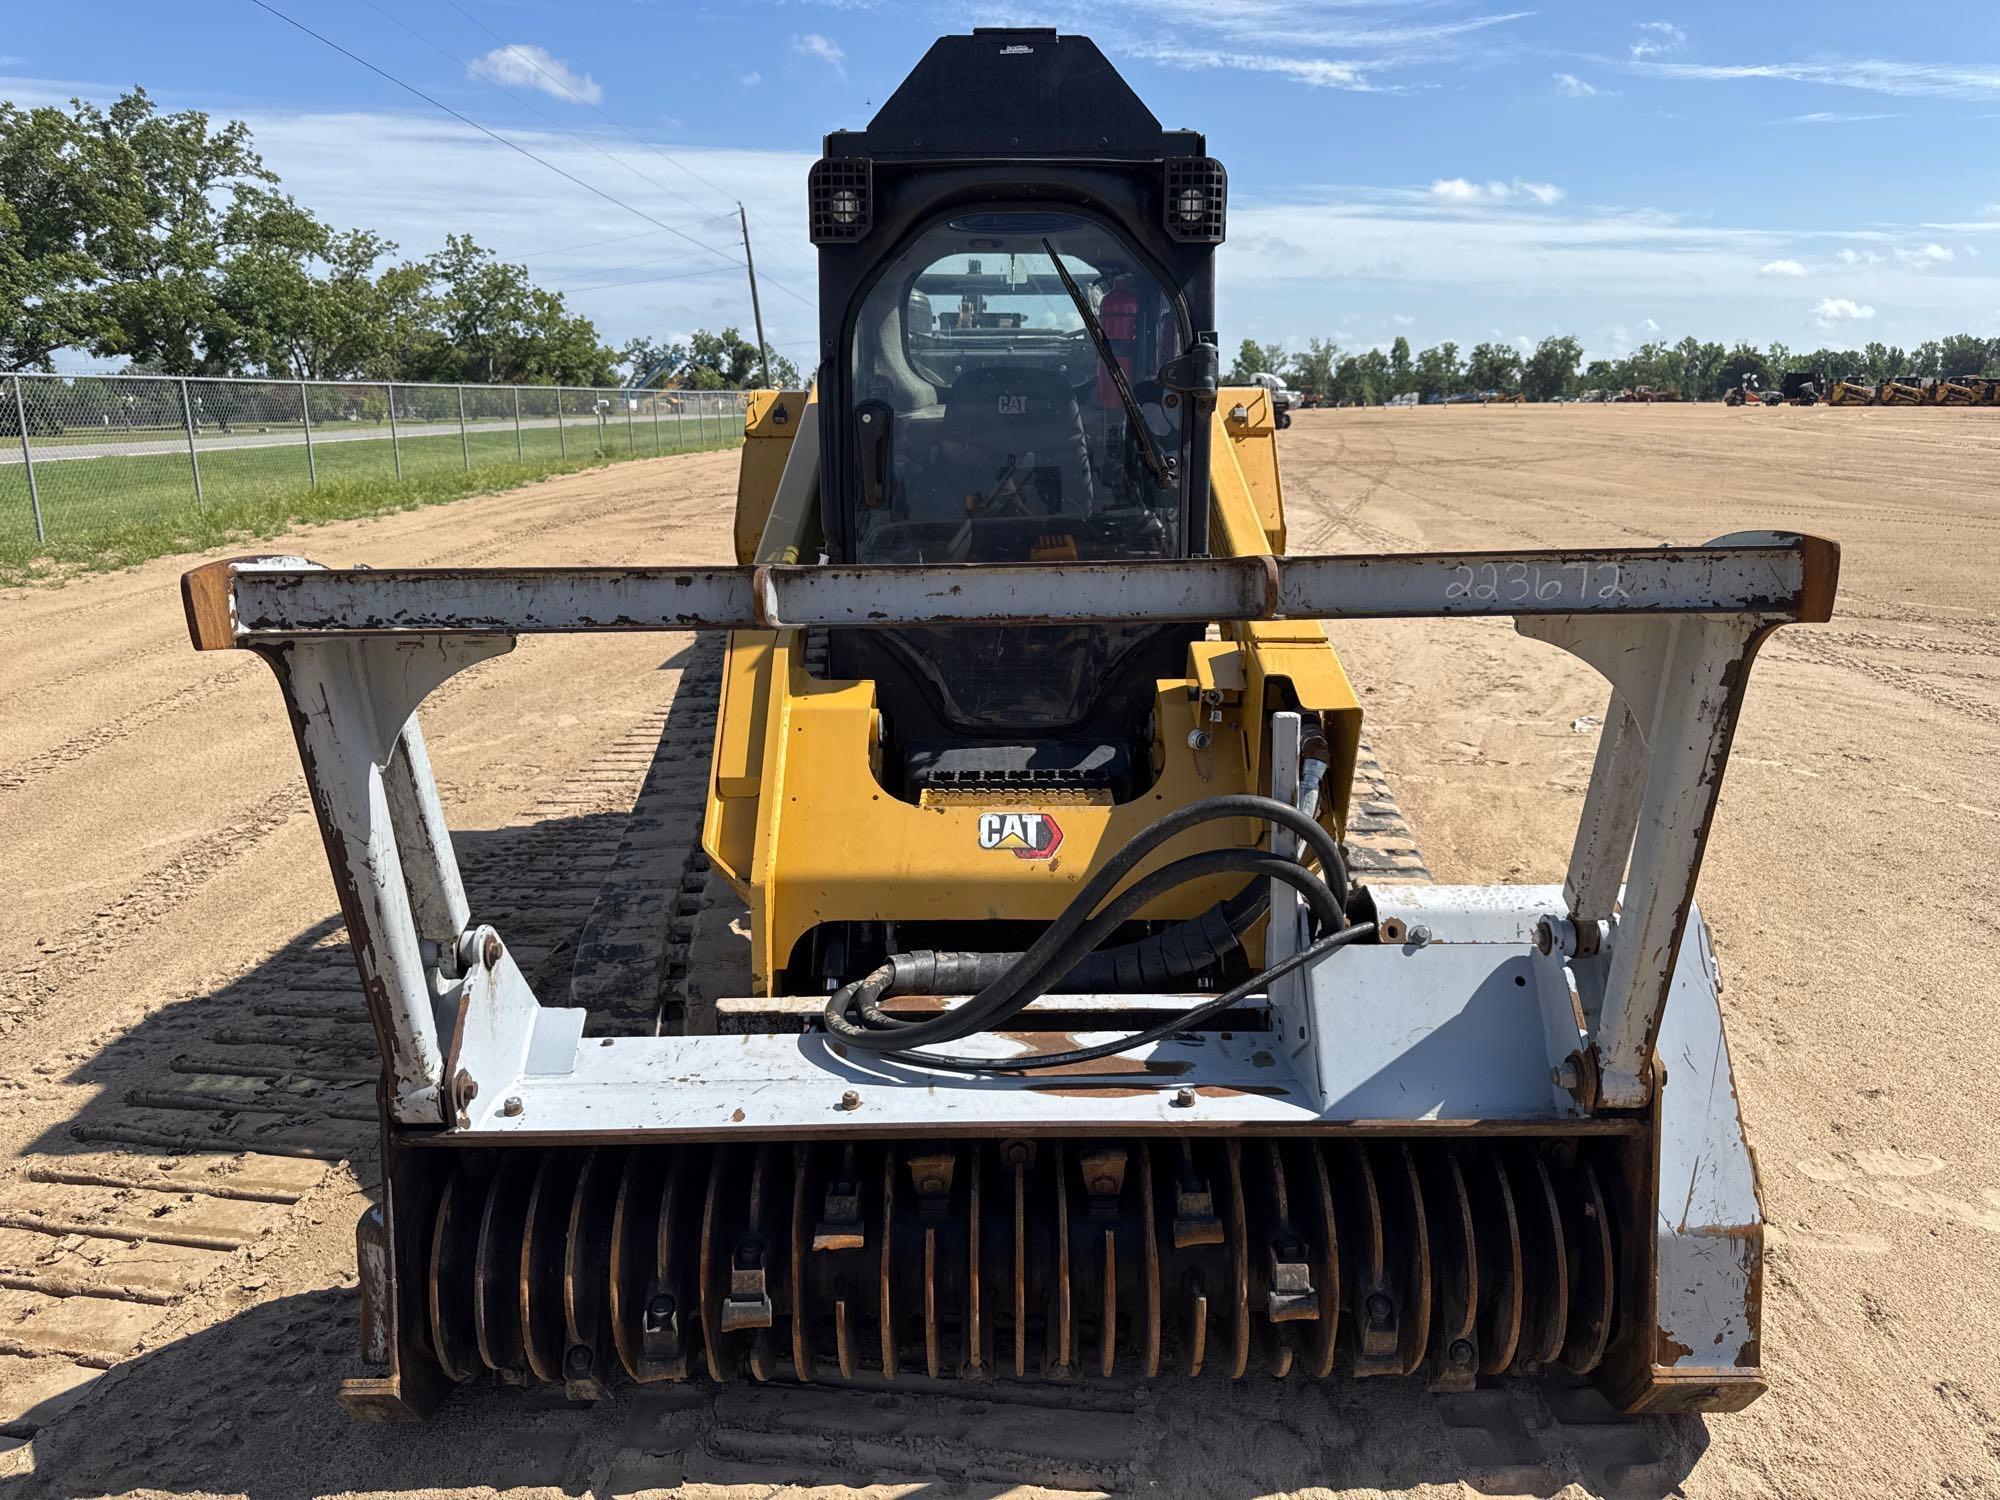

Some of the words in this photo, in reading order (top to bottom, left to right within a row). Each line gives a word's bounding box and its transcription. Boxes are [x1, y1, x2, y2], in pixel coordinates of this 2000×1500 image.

[998, 395, 1028, 414] CAT
[1445, 561, 1631, 601] 223672
[979, 813, 1042, 849] CAT
